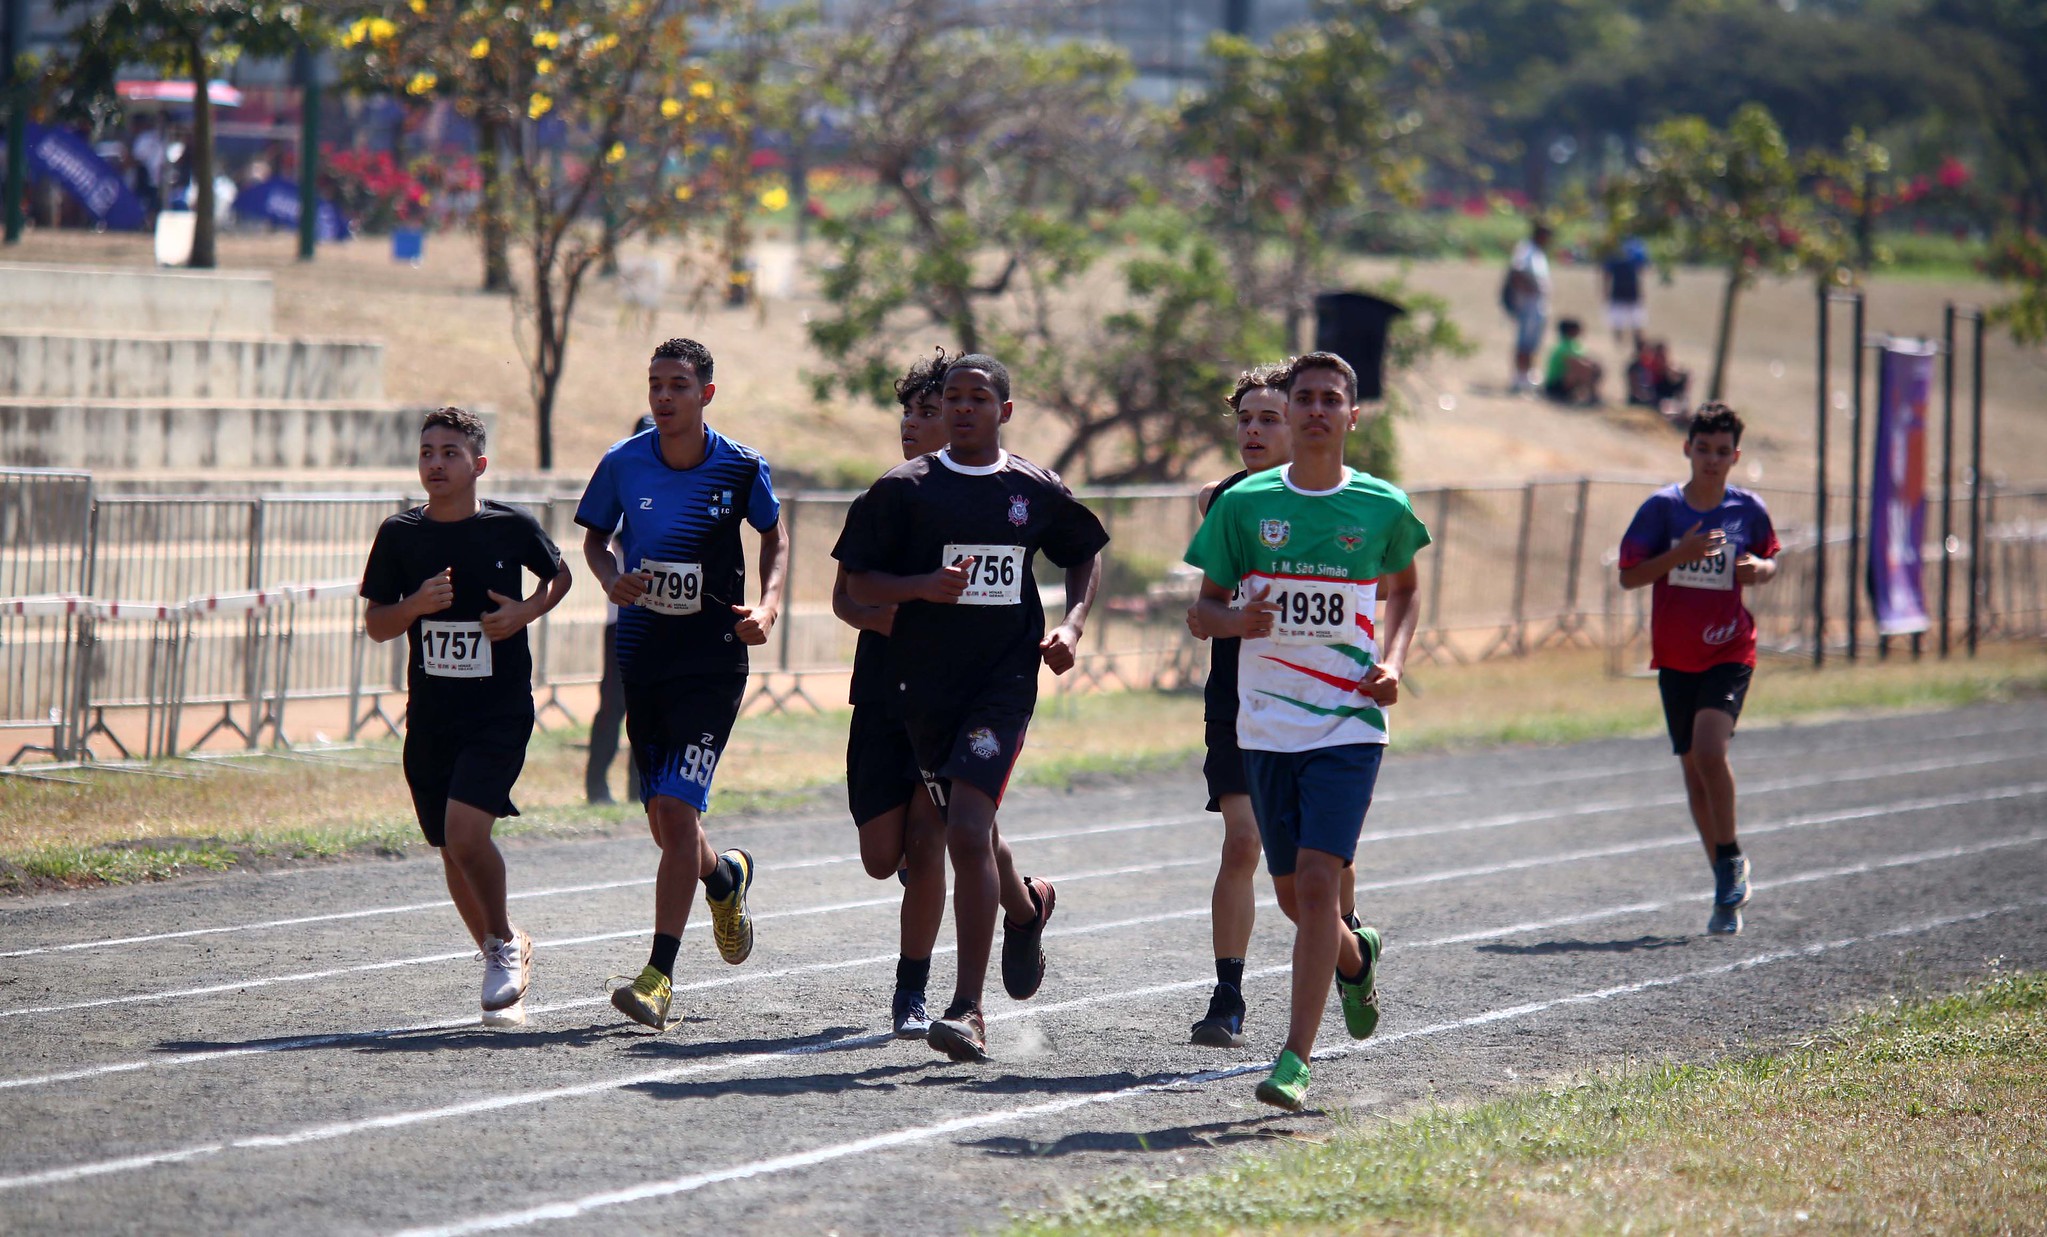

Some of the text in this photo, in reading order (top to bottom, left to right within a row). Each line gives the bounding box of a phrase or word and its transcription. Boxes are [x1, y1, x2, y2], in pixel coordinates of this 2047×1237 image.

[1295, 562, 1315, 575] São
[1317, 563, 1348, 578] Simão
[1276, 591, 1344, 626] 1938
[423, 630, 482, 660] 1757
[679, 744, 716, 788] 99
